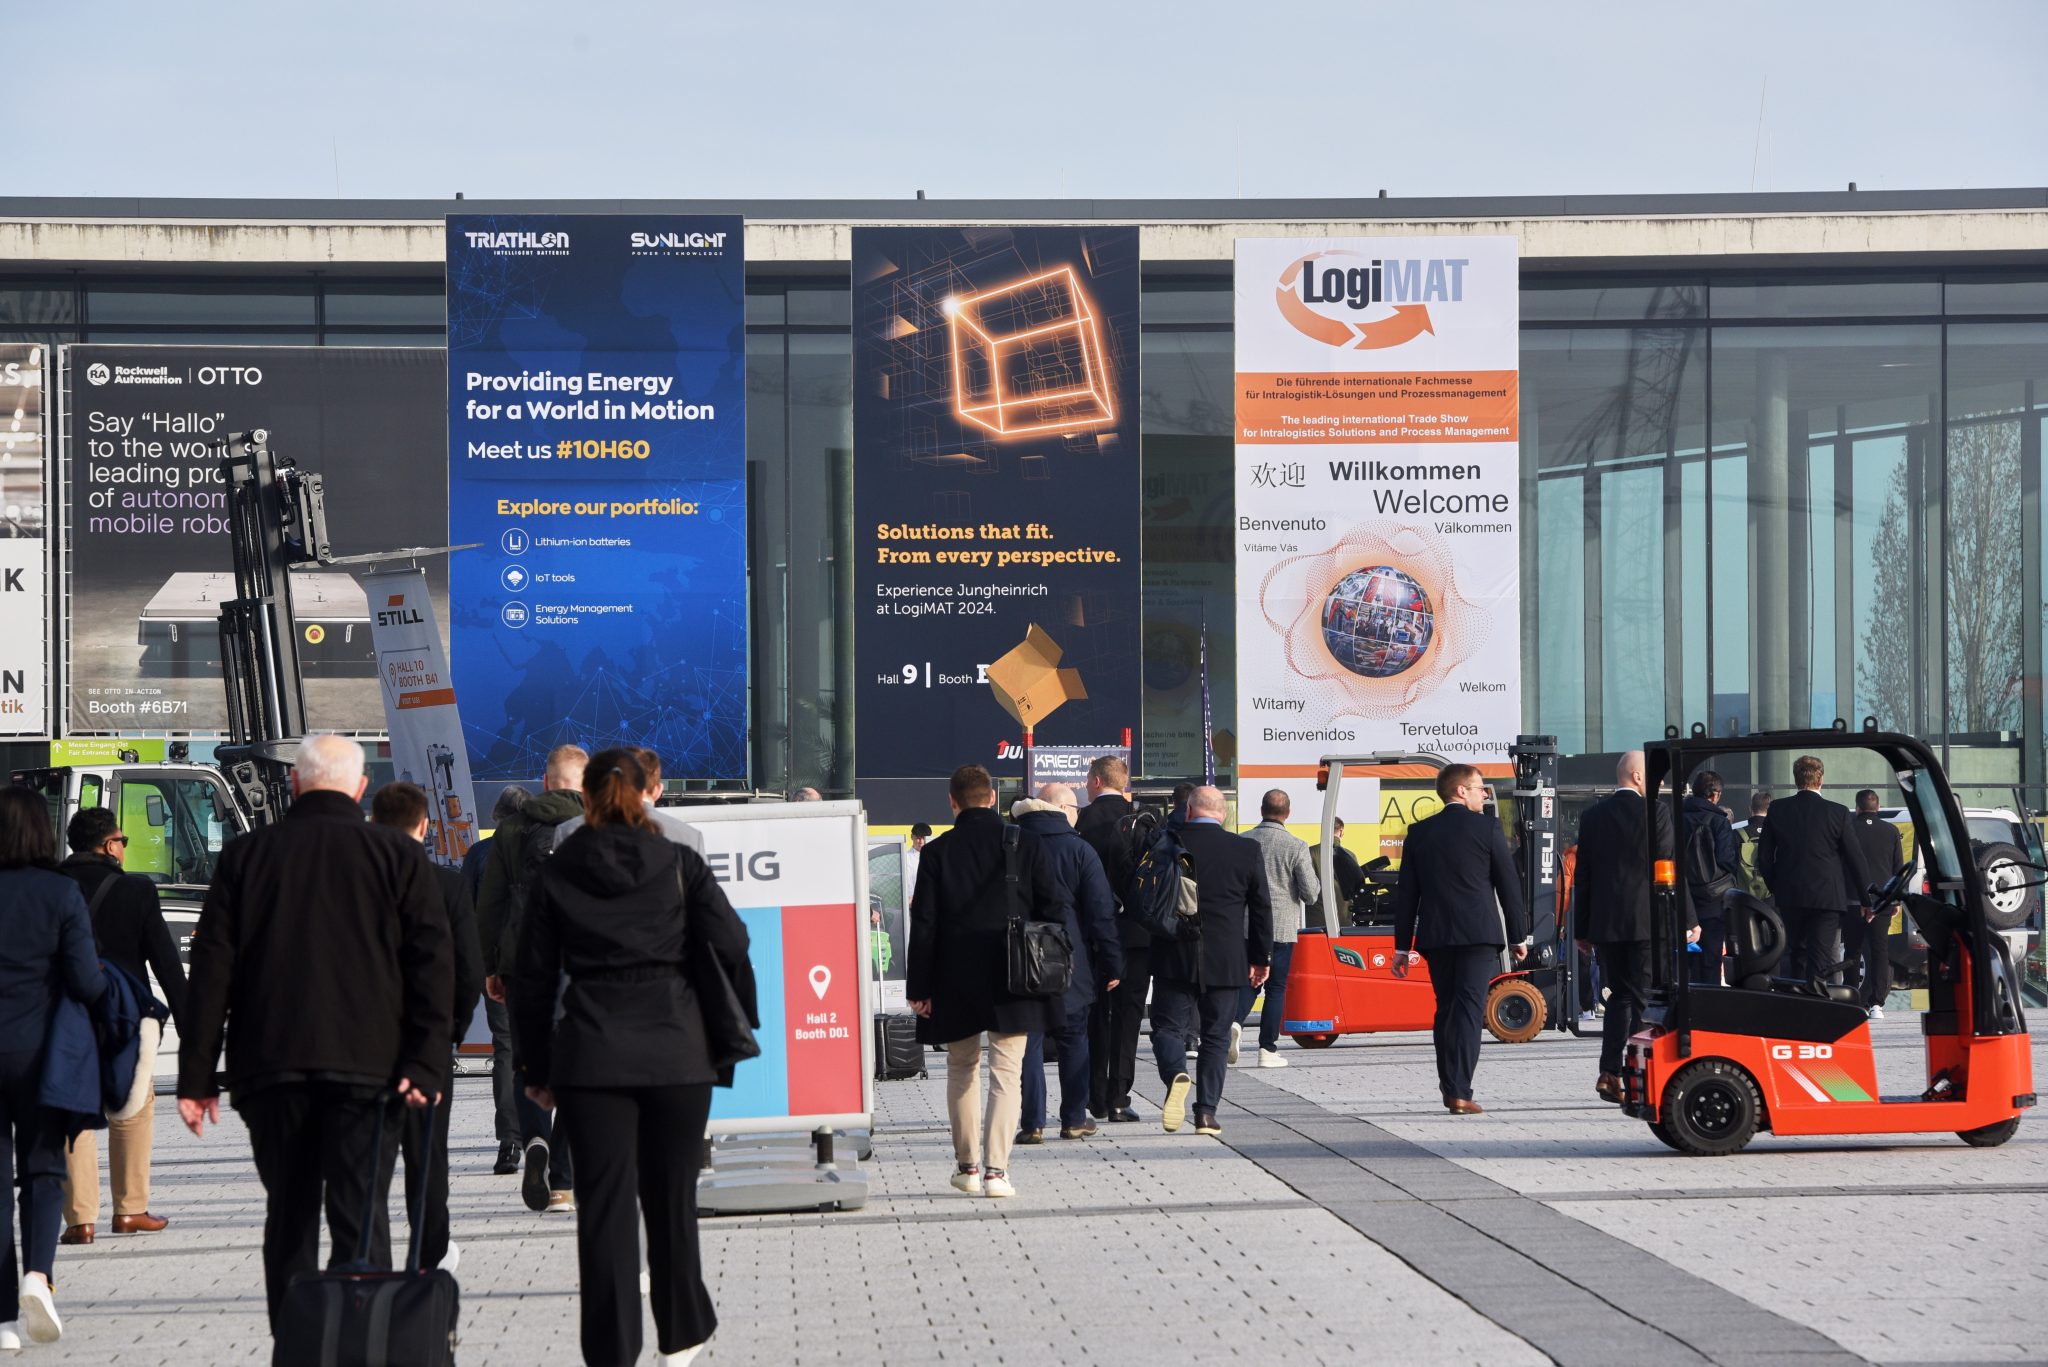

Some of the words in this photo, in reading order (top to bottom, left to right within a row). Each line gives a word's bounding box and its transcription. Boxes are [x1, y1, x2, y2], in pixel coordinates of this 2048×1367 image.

[464, 232, 570, 249] TRIATHLON
[631, 232, 727, 248] SUNLIGHT
[1303, 259, 1470, 310] LogiMAT
[114, 366, 168, 376] Rockwell
[198, 366, 263, 386] OTTO
[114, 375, 183, 385] Automation
[466, 370, 583, 396] Providing
[588, 373, 674, 396] Energy
[1276, 378, 1293, 387] Die
[1296, 377, 1341, 387] führende
[1343, 377, 1413, 386] internationale
[1415, 376, 1473, 386] Fachmesse
[1246, 390, 1260, 399] für
[1263, 390, 1376, 401] Intralogistik-Lösungen
[1379, 390, 1398, 399] und
[1401, 389, 1507, 400] Prozessmanagement
[466, 399, 502, 420] for
[507, 404, 522, 420] a
[526, 399, 599, 420] World
[604, 399, 626, 420] in
[631, 399, 715, 420] Motion
[88, 411, 134, 437] Say
[1281, 416, 1301, 425] The
[1303, 415, 1340, 427] leading
[1342, 415, 1406, 425] international
[1408, 414, 1438, 424] Trade
[1440, 414, 1469, 424] Show
[1243, 428, 1258, 438] for
[1260, 428, 1326, 439] Intralogistics
[1328, 427, 1377, 438] Solutions
[1379, 427, 1398, 437] and
[1401, 427, 1442, 437] Process
[1445, 426, 1510, 437] Management
[88, 440, 115, 458] to
[122, 437, 164, 458] the
[468, 441, 523, 459] Meet
[527, 445, 552, 459] us
[556, 440, 650, 460] #10H60
[89, 462, 180, 488] leading
[1250, 461, 1307, 489] 欢迎
[1329, 460, 1481, 481] Willkommen
[89, 488, 115, 509] of
[121, 490, 227, 509] autonom
[1373, 488, 1509, 514] Welcome
[497, 499, 571, 518] Explore
[574, 502, 608, 515] our
[610, 497, 698, 518] portfolio:
[89, 513, 174, 534] mobile
[182, 513, 232, 534] robo
[877, 523, 975, 540] Solutions
[979, 523, 1021, 540] that
[1025, 523, 1054, 540] fit.
[1239, 516, 1326, 531] Benvenuto
[1434, 521, 1512, 534] Välkommen
[535, 537, 588, 546] Lithium-ion
[589, 537, 631, 546] batteries
[1280, 543, 1298, 552] Vás
[877, 548, 931, 564] From
[936, 551, 993, 567] every
[998, 547, 1121, 567] perspective.
[535, 573, 551, 583] IoT
[552, 573, 576, 583] tools
[877, 584, 953, 600] Experience
[957, 584, 1048, 600] Jungheinrich
[535, 604, 569, 615] Energy
[570, 603, 633, 615] Management
[877, 603, 890, 615] at
[894, 602, 954, 618] LogiMAT
[958, 602, 997, 615] 2024.
[377, 608, 425, 627] STILL
[535, 615, 579, 625] Solutions
[397, 660, 414, 673] HALL
[414, 659, 424, 672] 10
[877, 673, 899, 685] Hall
[902, 663, 918, 685] 9
[938, 673, 973, 685] Booth
[398, 675, 424, 688] BOOTH
[425, 672, 439, 685] B41
[1459, 681, 1506, 693] Welkom
[89, 700, 135, 714] Booth
[139, 700, 188, 714] #6B71
[1252, 696, 1306, 713] Witamy
[1263, 727, 1356, 742] Bienvenidos
[1400, 722, 1478, 736] Tervetuloa
[90, 741, 116, 750] Eingang
[1034, 754, 1080, 769] KRIEG
[1380, 839, 1404, 847] ACHH
[1541, 832, 1554, 884] HELI
[705, 850, 781, 883] EIG
[1339, 952, 1355, 965] 20
[806, 1012, 828, 1025] Hall
[830, 1012, 837, 1024] 2
[795, 1027, 827, 1041] Booth
[829, 1026, 849, 1039] D01
[1772, 1044, 1793, 1060] G
[1798, 1044, 1833, 1059] 30
